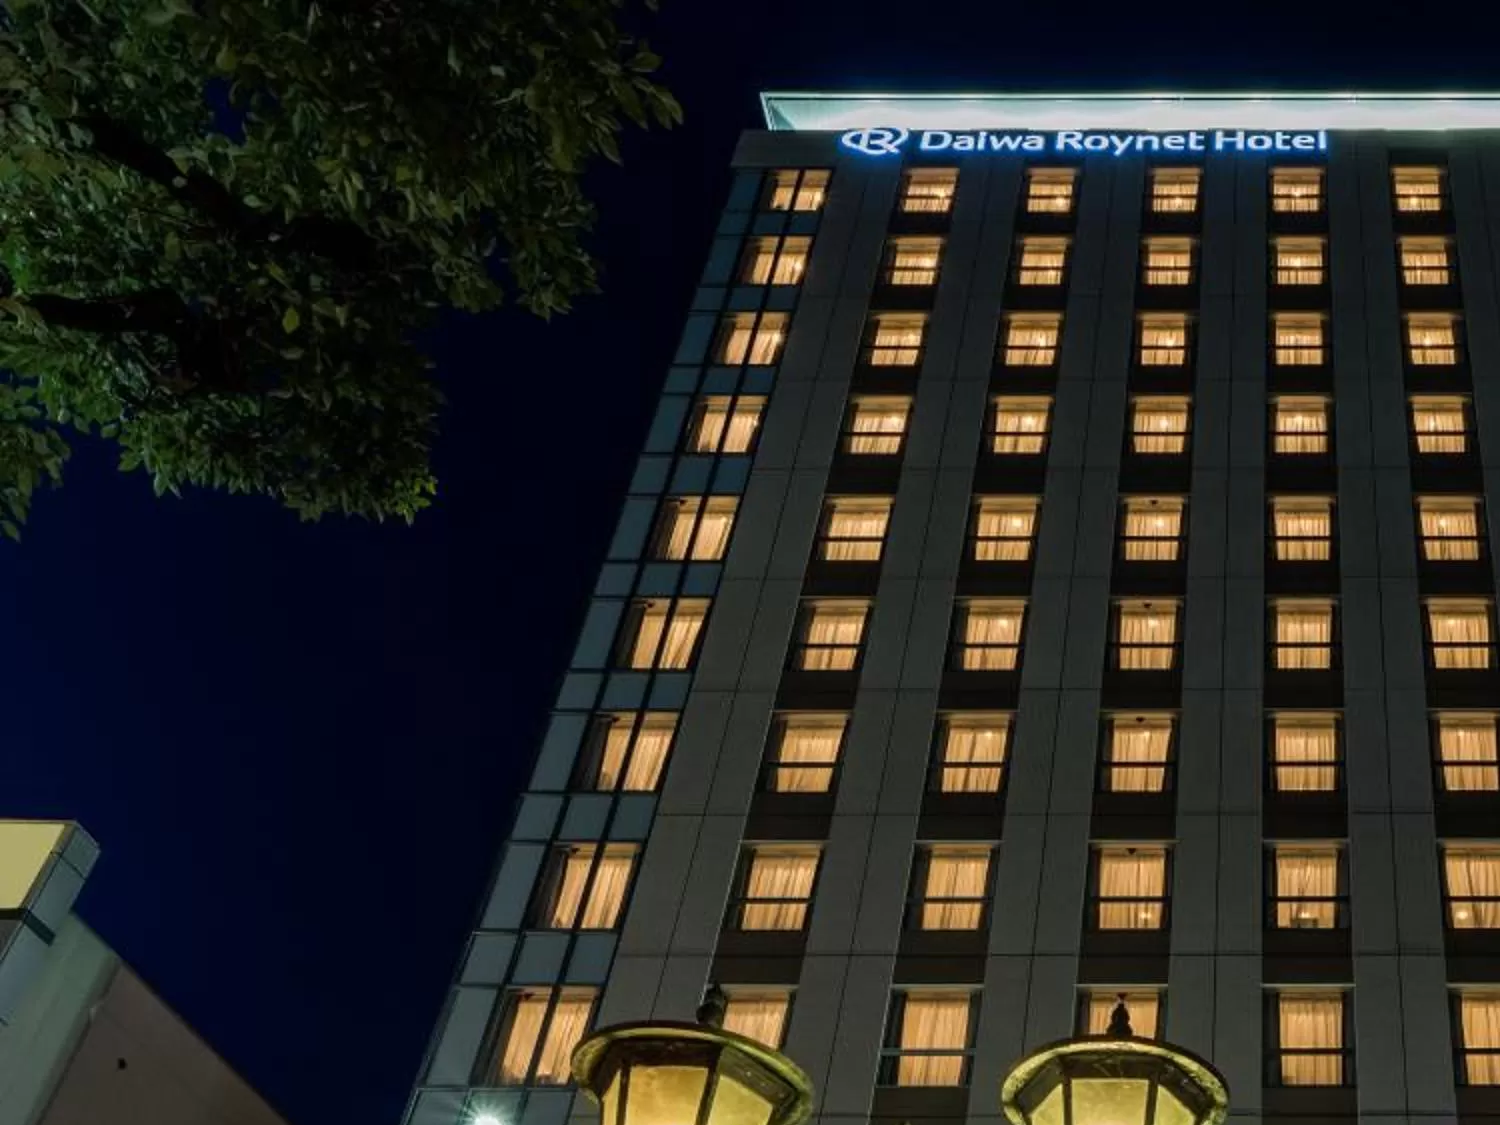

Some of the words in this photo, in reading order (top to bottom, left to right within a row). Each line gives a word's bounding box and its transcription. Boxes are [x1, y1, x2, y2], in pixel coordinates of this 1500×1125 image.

[920, 130, 1044, 152] Daiwa
[1055, 130, 1205, 156] Roynet
[1215, 130, 1327, 152] Hotel
